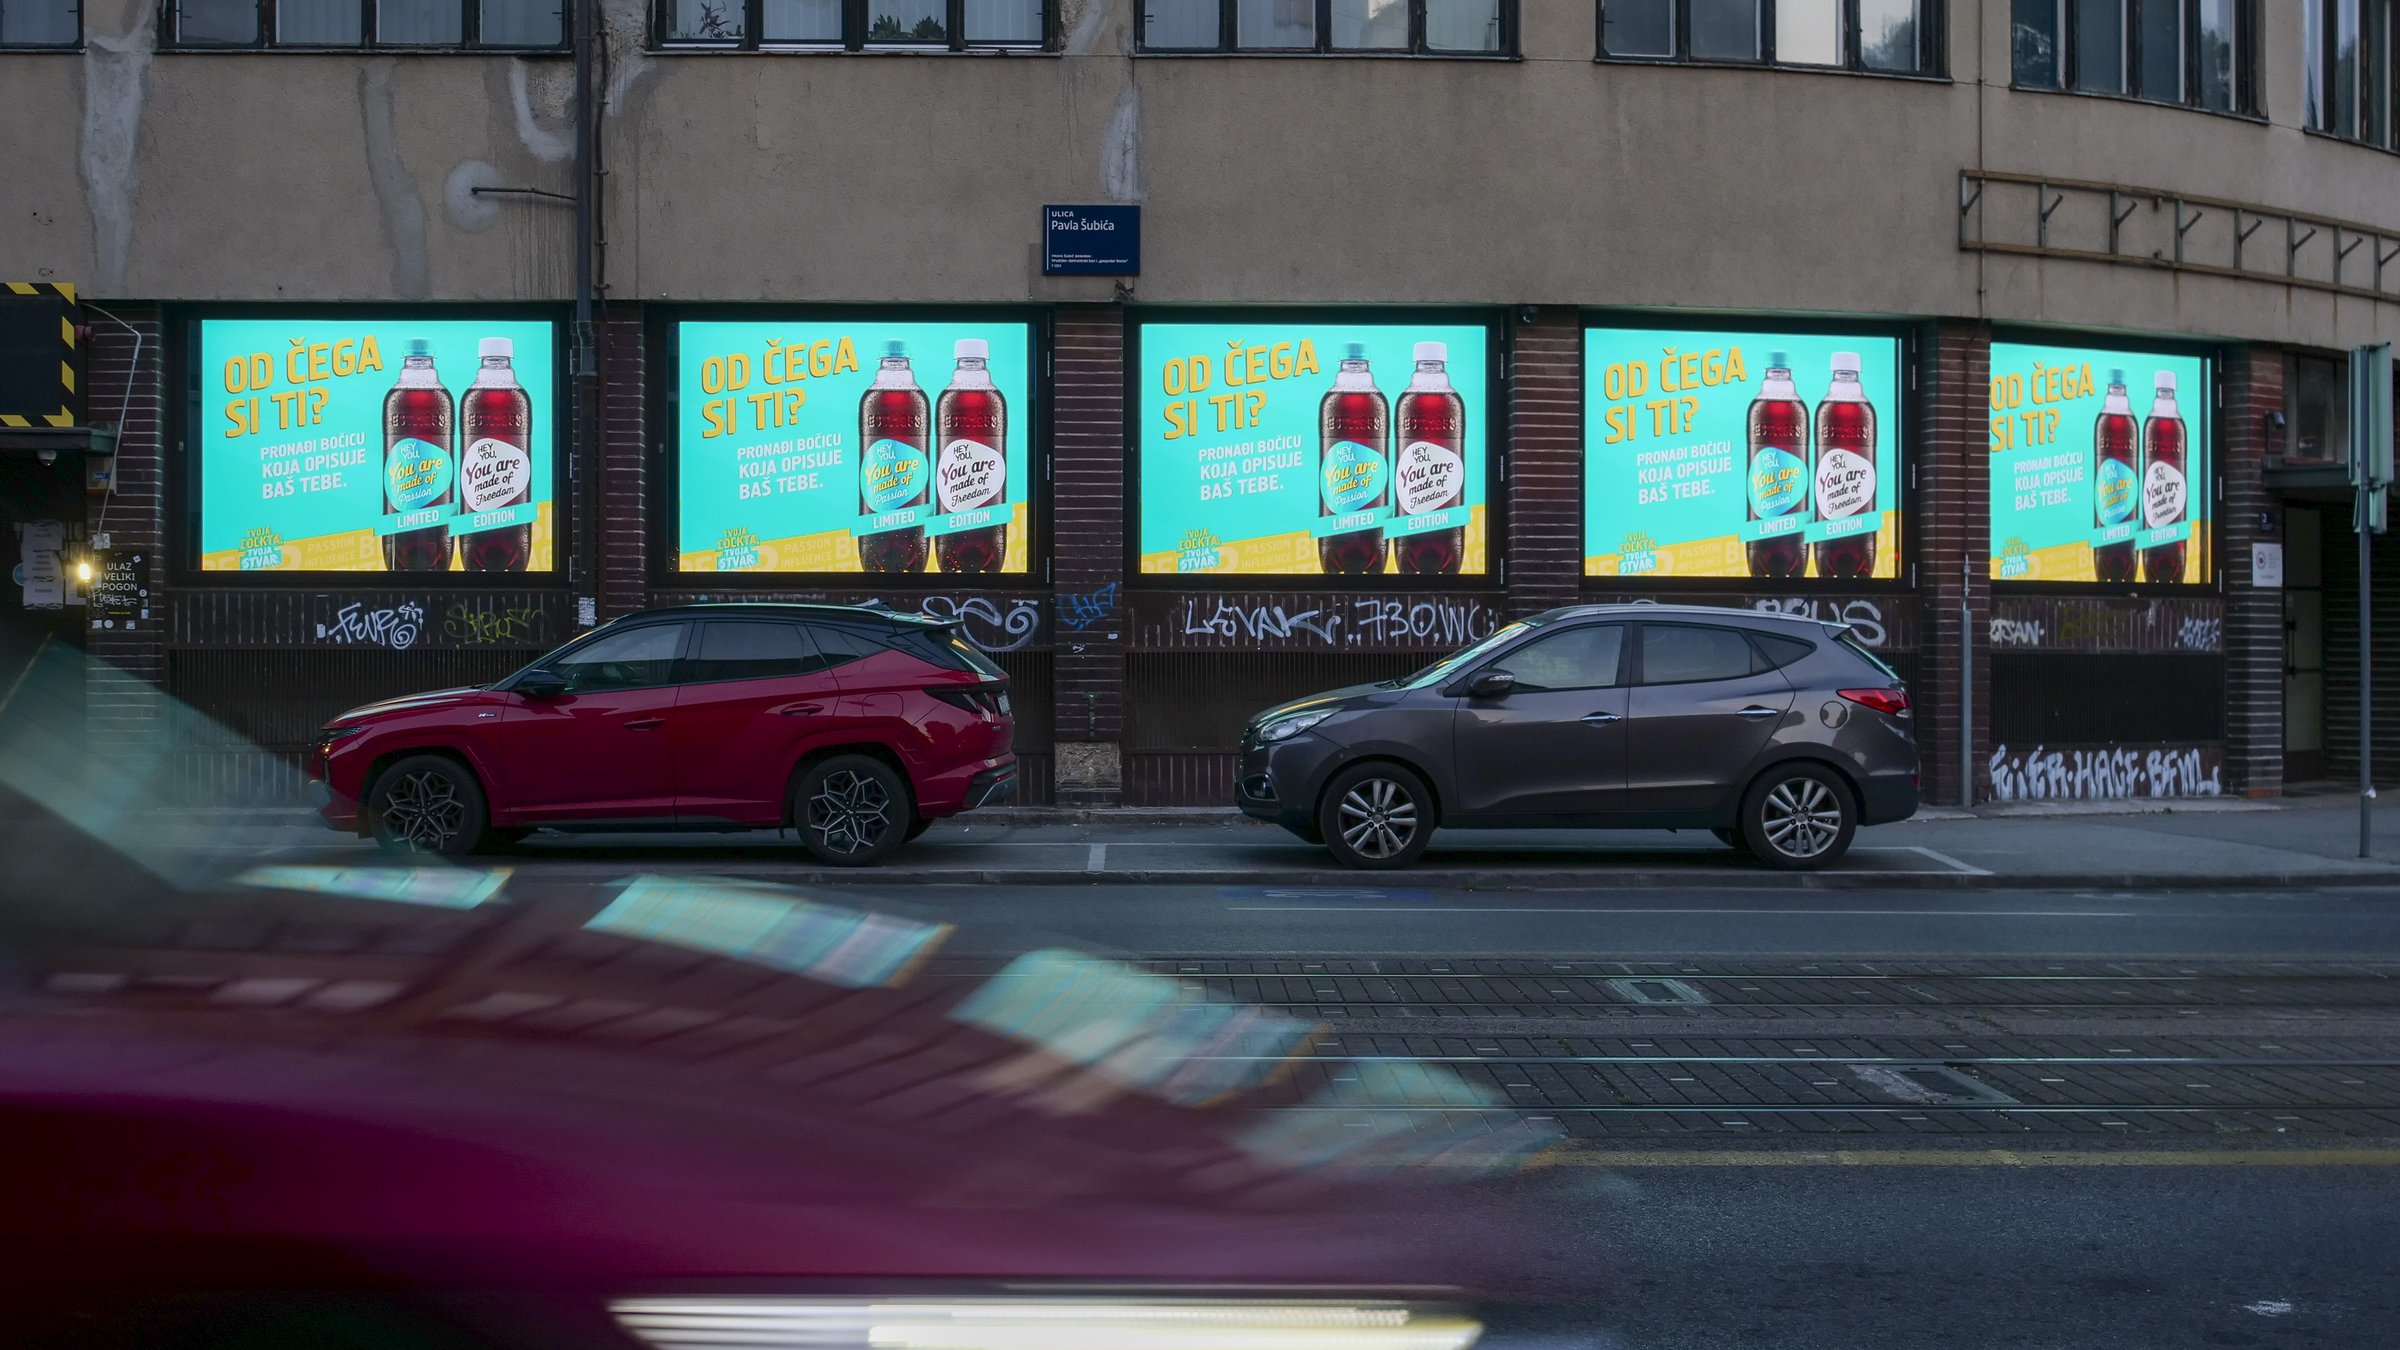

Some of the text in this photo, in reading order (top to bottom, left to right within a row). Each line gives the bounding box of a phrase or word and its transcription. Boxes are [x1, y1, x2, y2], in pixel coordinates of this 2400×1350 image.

[1051, 218, 1115, 231] Pavla Šubića
[225, 334, 383, 394] OD ČEGA
[702, 336, 860, 394] OD ČEGA
[1163, 338, 1320, 396] OD ČEGA
[1605, 346, 1747, 400] OD ČEGA
[1990, 361, 2095, 411] OD ČEGA
[225, 387, 330, 438] SI TI?
[702, 388, 807, 439] SI TI?
[1164, 390, 1267, 440] SI TI?
[1605, 396, 1700, 444] SI TI?
[1990, 408, 2060, 452] SI TI?
[261, 432, 365, 460] PRONAĐI BOČICU
[401, 443, 416, 453] HEY
[478, 443, 494, 454] HEY
[738, 433, 842, 460] PRONAĐI BOČICU
[877, 444, 892, 454] HEY
[954, 444, 969, 455] HEY
[1199, 435, 1302, 462] PRONAĐI BOČICU
[1337, 446, 1352, 456] HEY
[1413, 447, 1428, 457] HEY
[1691, 440, 1731, 458] BOČICU
[262, 448, 366, 478] KOJA OPISUJE
[739, 449, 842, 479] KOJA OPISUJE
[1200, 451, 1302, 480] KOJA OPISUJE
[1639, 456, 1732, 484] KOJA OPISUJE
[1830, 454, 1844, 464] HEY
[389, 458, 443, 484] You are
[397, 472, 436, 492] made of
[466, 458, 520, 485] You are
[474, 471, 514, 492] made of
[865, 459, 919, 485] You are
[942, 459, 995, 486] You are
[1325, 461, 1378, 487] You are
[1400, 461, 1454, 488] You are
[1752, 467, 1800, 492] You are
[1820, 468, 1867, 494] You are
[2016, 474, 2041, 491] KOJA
[2044, 466, 2083, 486] OPISUJE
[262, 472, 347, 499] BAŠ TEBE.
[739, 472, 824, 500] BAŠ TEBE.
[873, 472, 912, 493] made of
[950, 472, 989, 493] made of
[1200, 474, 1284, 501] BAŠ TEBE.
[1333, 474, 1372, 494] made of
[1409, 475, 1447, 495] made of
[1639, 482, 1668, 504] BAŠ
[1759, 480, 1794, 499] made of
[1827, 481, 1861, 500] made of
[2146, 483, 2162, 504] You
[2165, 481, 2180, 494] are
[400, 488, 433, 504] Passion
[476, 486, 515, 506] Freedom
[876, 488, 909, 505] Passion
[952, 487, 990, 507] Freedom
[1335, 490, 1368, 507] Passion
[1410, 489, 1448, 508] Freedom
[1828, 496, 1862, 514] Freedom
[2016, 489, 2038, 511] BAŠ
[397, 509, 515, 528] LIMITED EDITION
[873, 510, 990, 529] LIMITED EDITION
[1332, 512, 1448, 530] LIMITED EDITION
[1759, 517, 1862, 535] LIMITED EDITION
[2102, 526, 2176, 543] LIMITED EDITION
[107, 562, 132, 570] ULAZ
[102, 583, 138, 591] POGON
